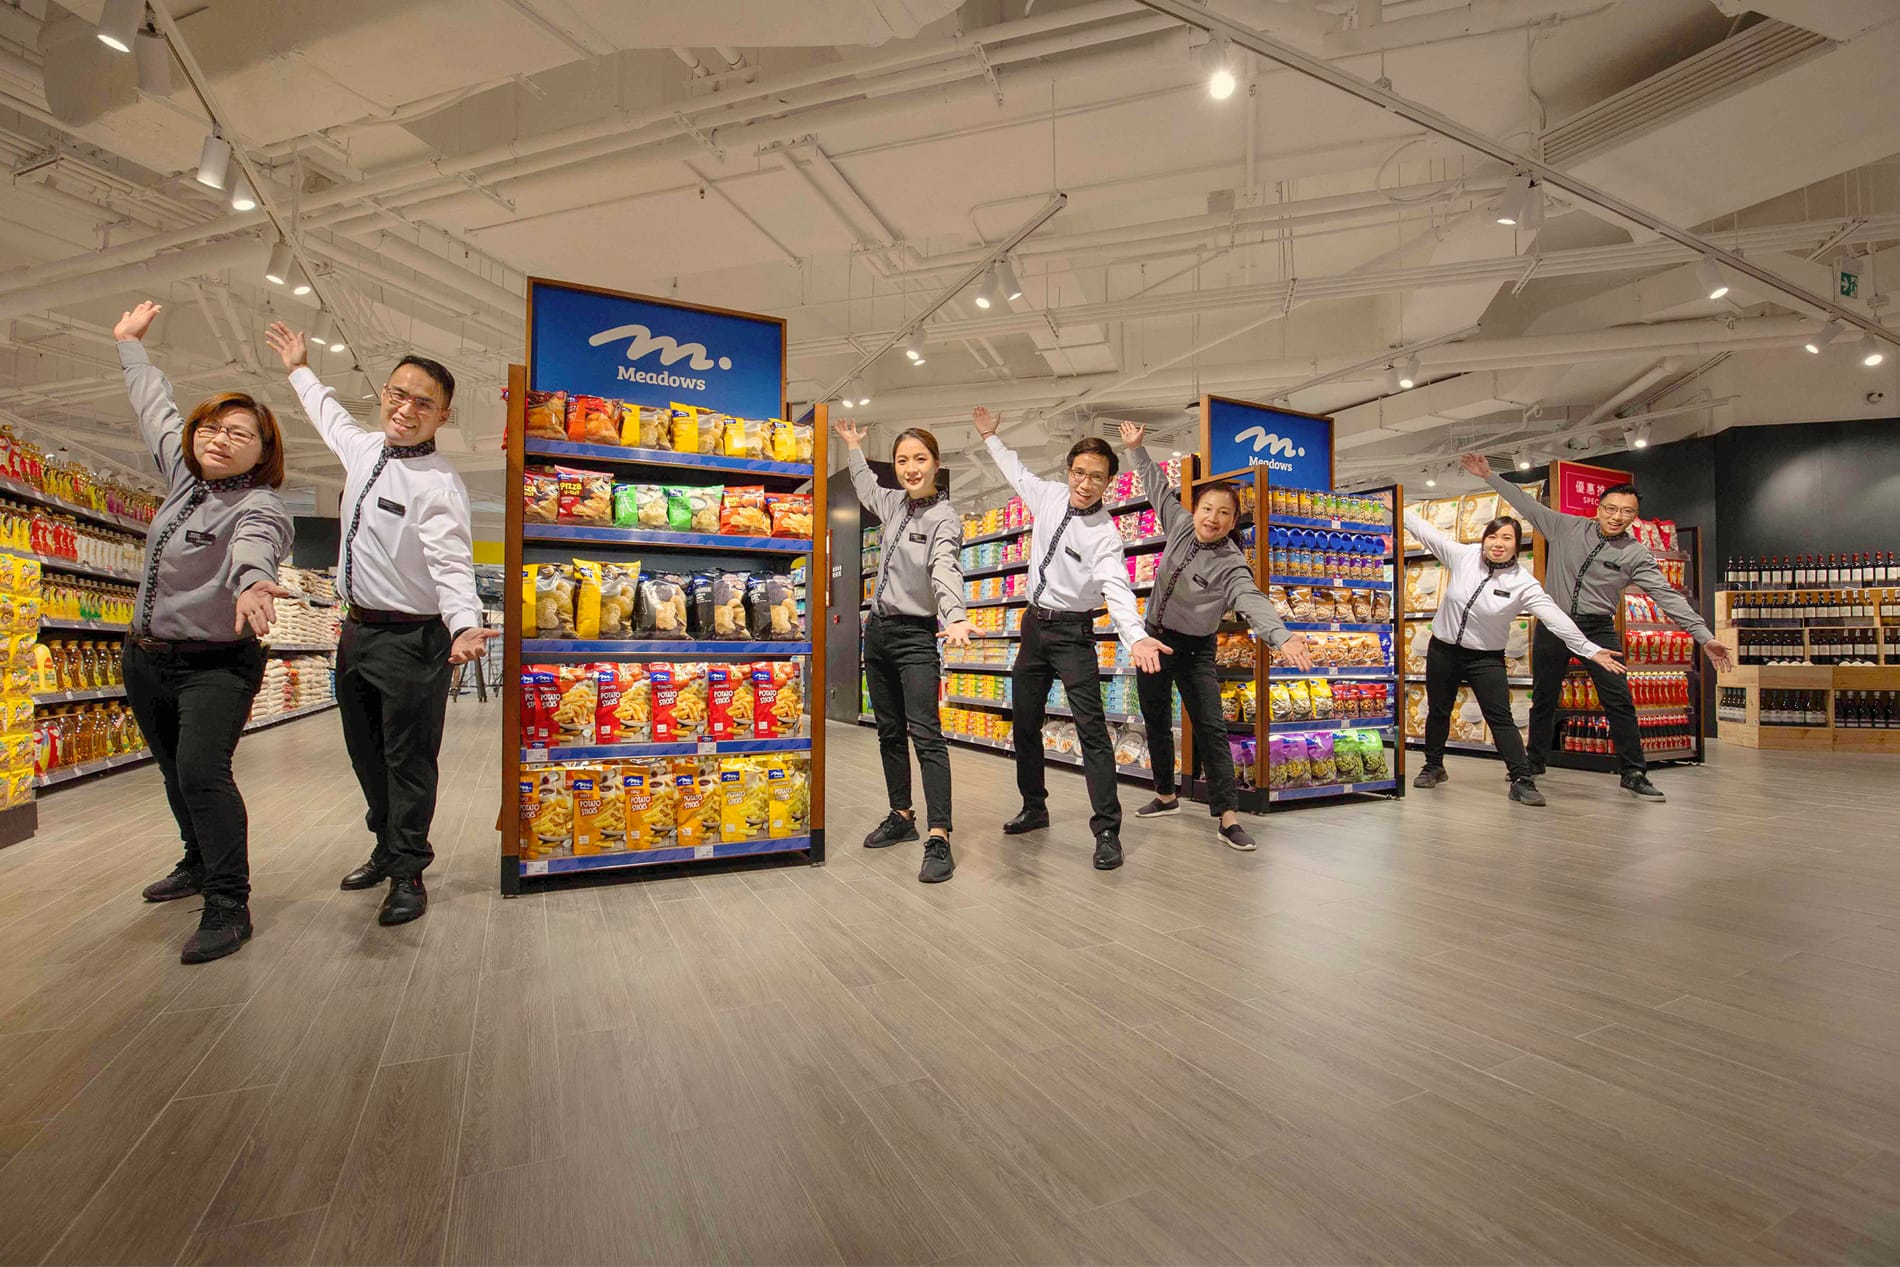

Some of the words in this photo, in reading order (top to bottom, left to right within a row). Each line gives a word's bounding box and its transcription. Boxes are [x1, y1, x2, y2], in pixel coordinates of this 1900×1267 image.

[616, 365, 706, 391] Meadows
[600, 691, 621, 699] POTATO
[630, 795, 651, 804] POTATO
[683, 794, 703, 802] POTATO
[580, 799, 601, 808] POTATO
